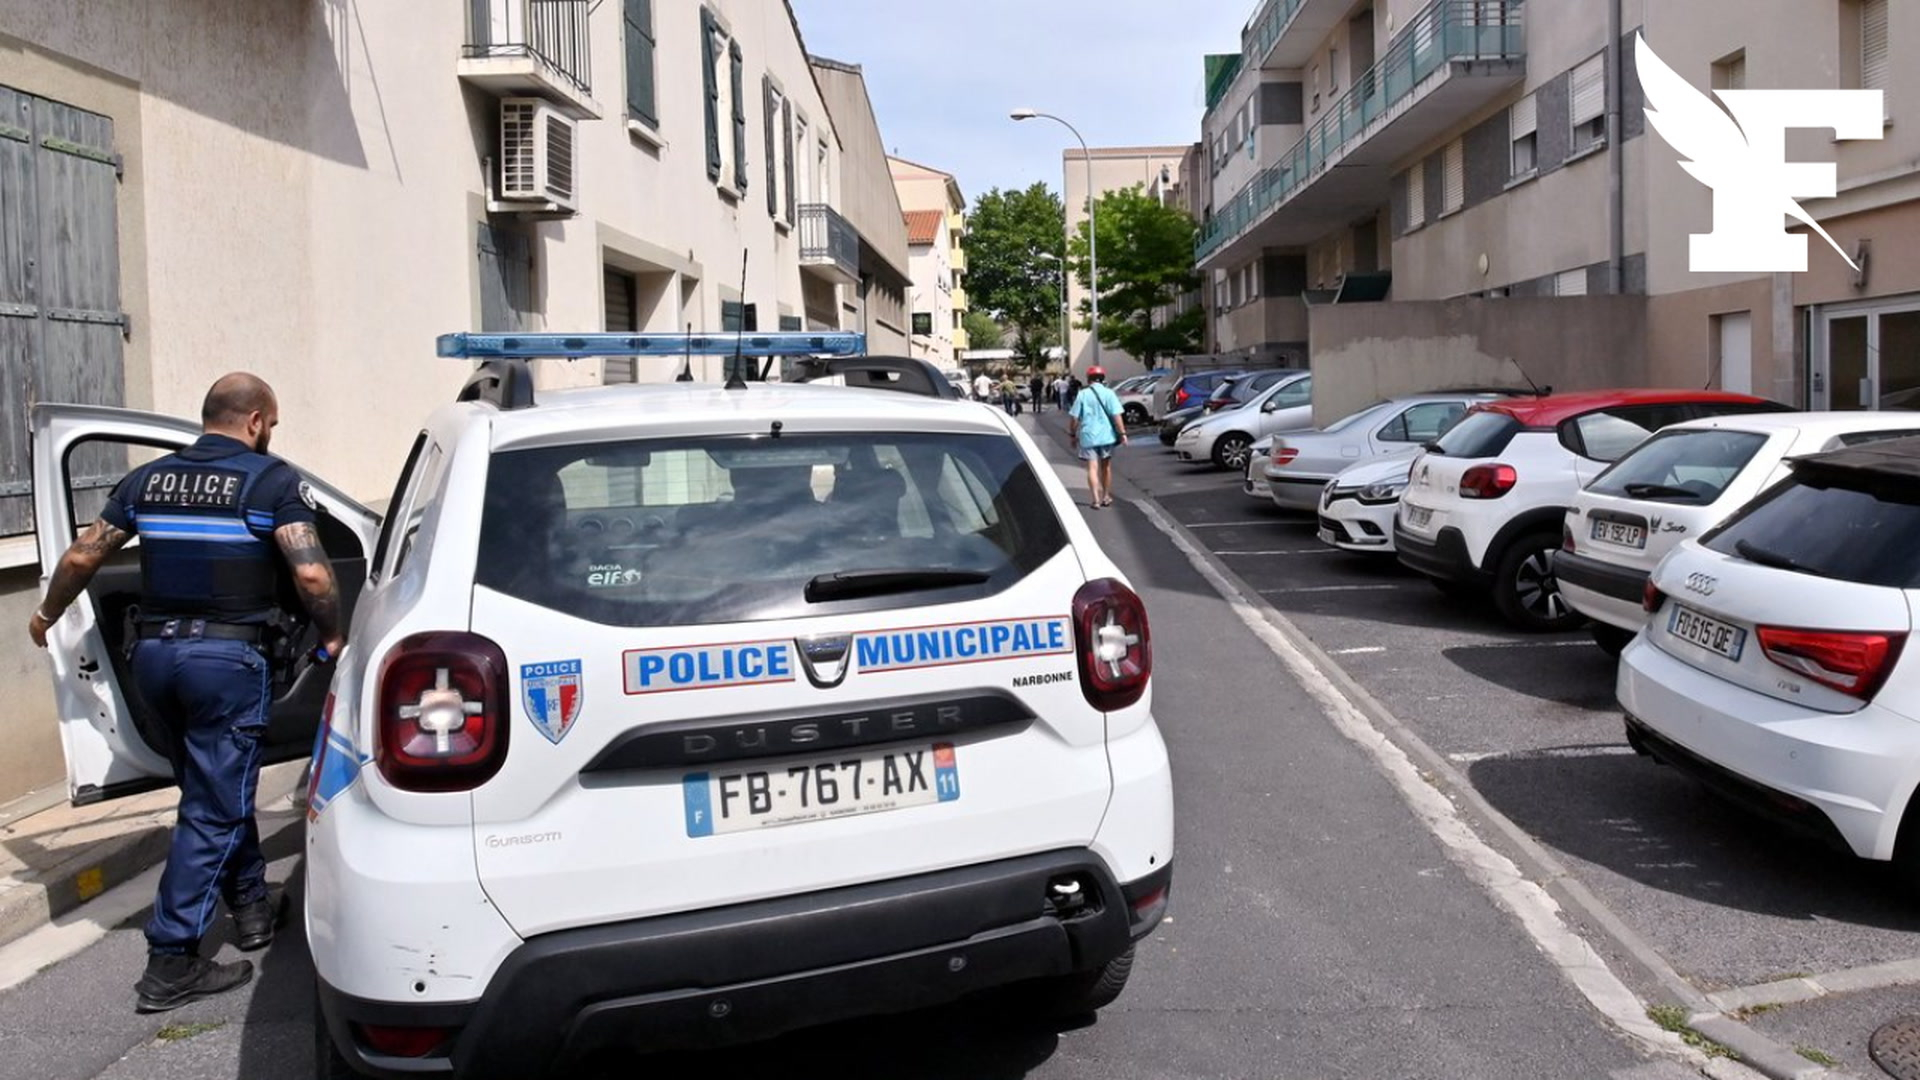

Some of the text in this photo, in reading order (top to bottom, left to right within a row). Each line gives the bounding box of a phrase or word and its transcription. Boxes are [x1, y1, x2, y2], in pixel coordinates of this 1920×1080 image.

[146, 473, 238, 495] POLICE
[144, 493, 231, 504] MUNICIPALE
[588, 571, 622, 585] elf
[639, 620, 1064, 686] POLICE MUNICIPALE
[525, 662, 577, 677] POLICE
[1012, 670, 1073, 688] NARBONNE
[682, 705, 964, 754] DUSTER
[718, 750, 929, 819] FB-767-AX
[939, 773, 957, 795] 11
[694, 810, 703, 824] F
